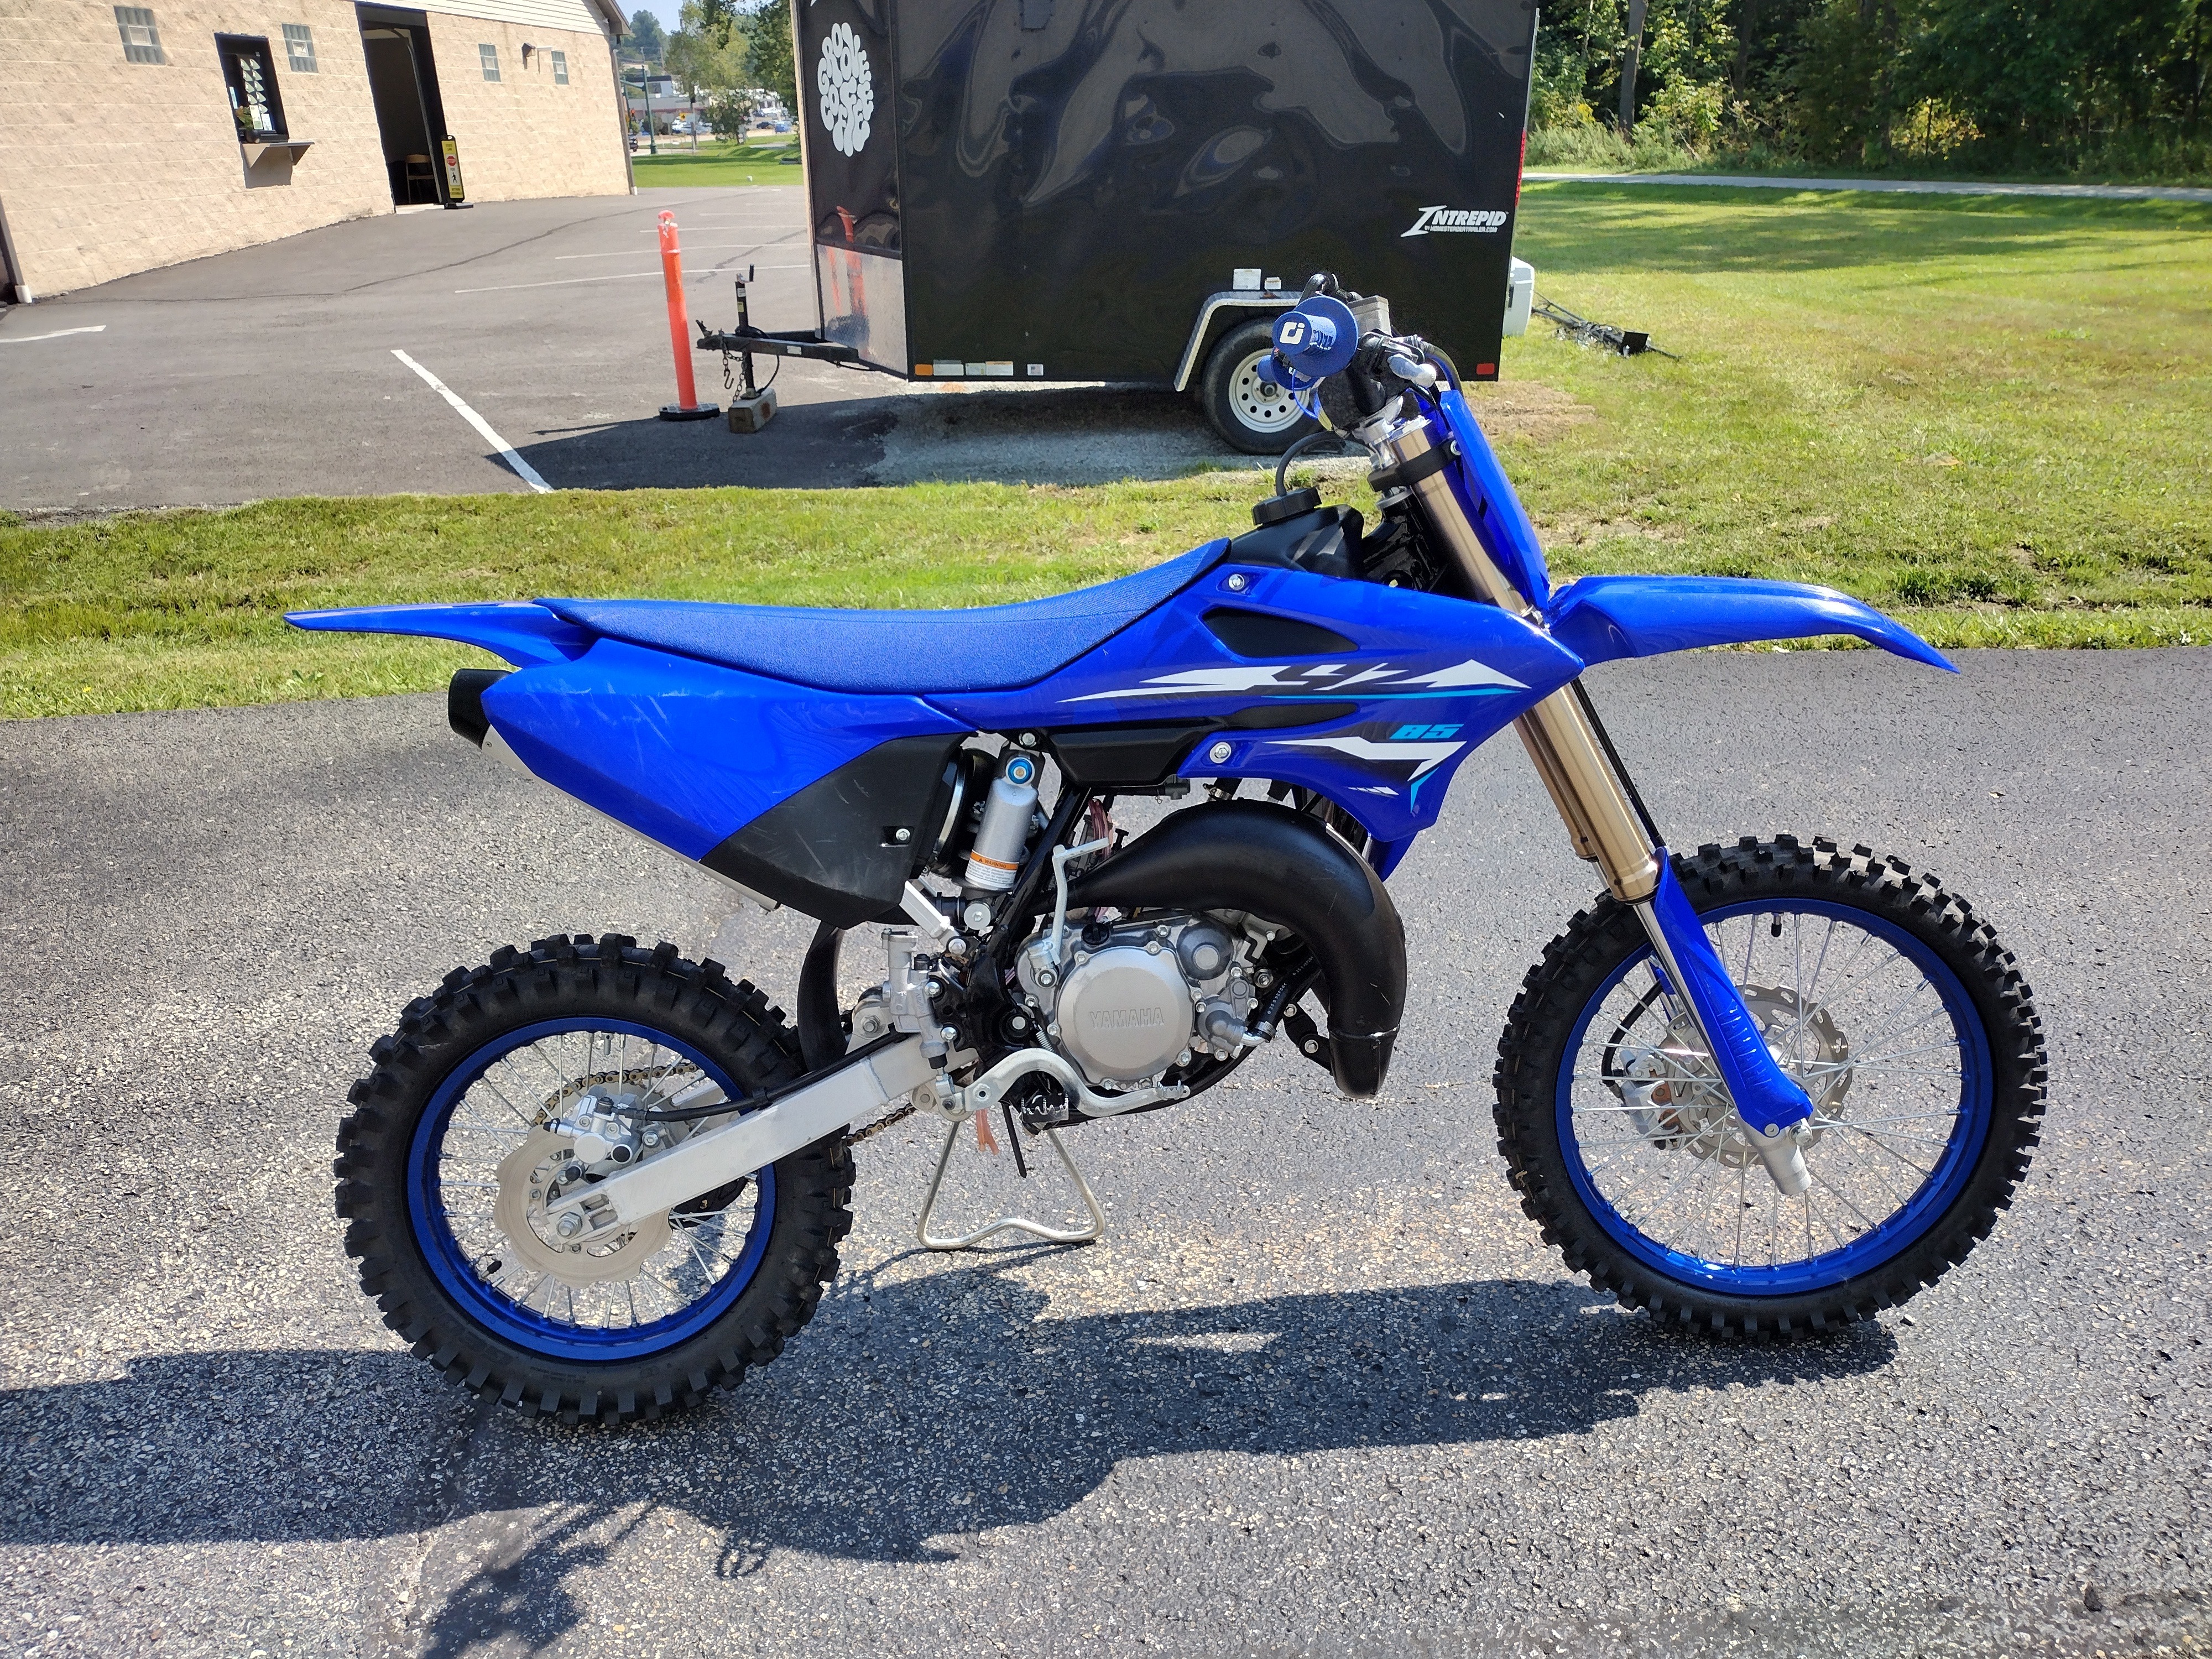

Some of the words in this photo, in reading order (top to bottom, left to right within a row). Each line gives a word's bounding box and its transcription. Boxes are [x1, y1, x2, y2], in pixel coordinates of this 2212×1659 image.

[817, 22, 872, 95] GROOVE
[820, 76, 874, 157] COFFEE
[1400, 205, 1507, 237] INTREPID
[1389, 723, 1464, 740] 85
[985, 859, 1007, 868] WARNING
[1089, 1006, 1165, 1030] YAMAHA
